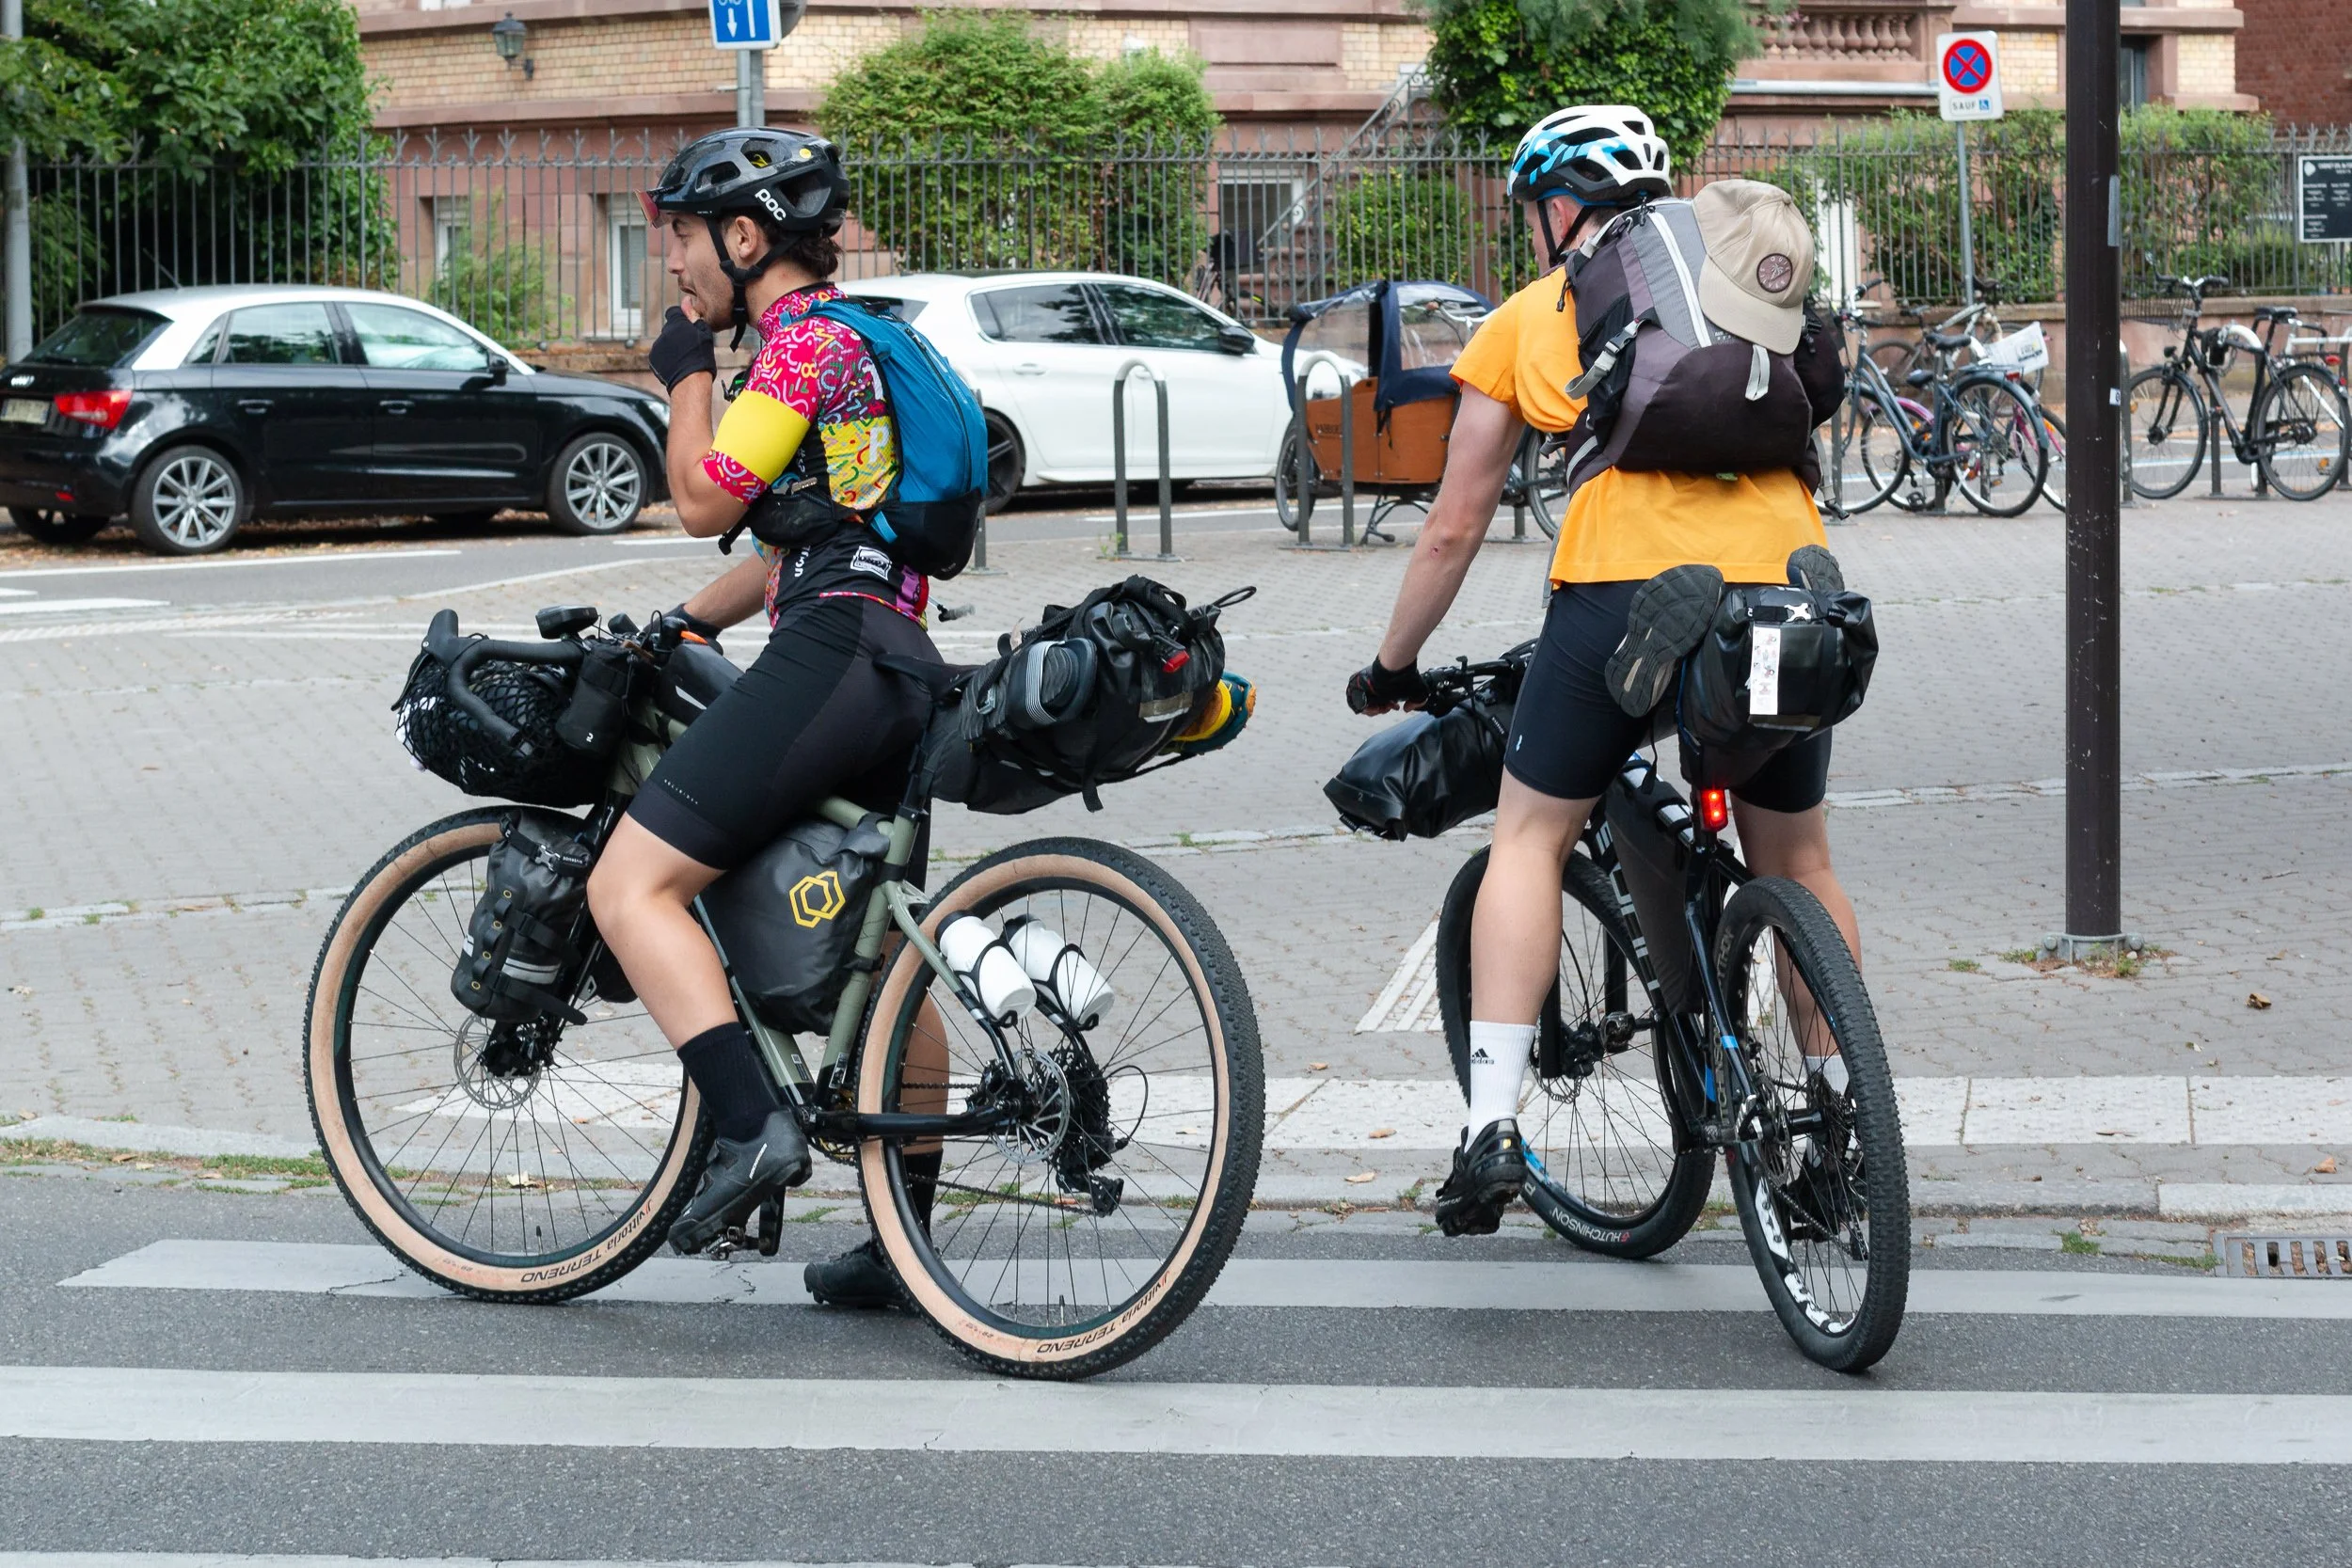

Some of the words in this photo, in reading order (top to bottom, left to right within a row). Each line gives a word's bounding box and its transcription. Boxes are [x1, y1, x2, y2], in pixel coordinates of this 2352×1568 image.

[1952, 101, 1976, 111] SAUF
[607, 1211, 645, 1249] vittoria
[1551, 1207, 1622, 1243] HUTCHINSON
[520, 1249, 602, 1283] TERRENO
[1121, 1282, 1163, 1323] vittoria
[1037, 1323, 1116, 1354] TERRENO
